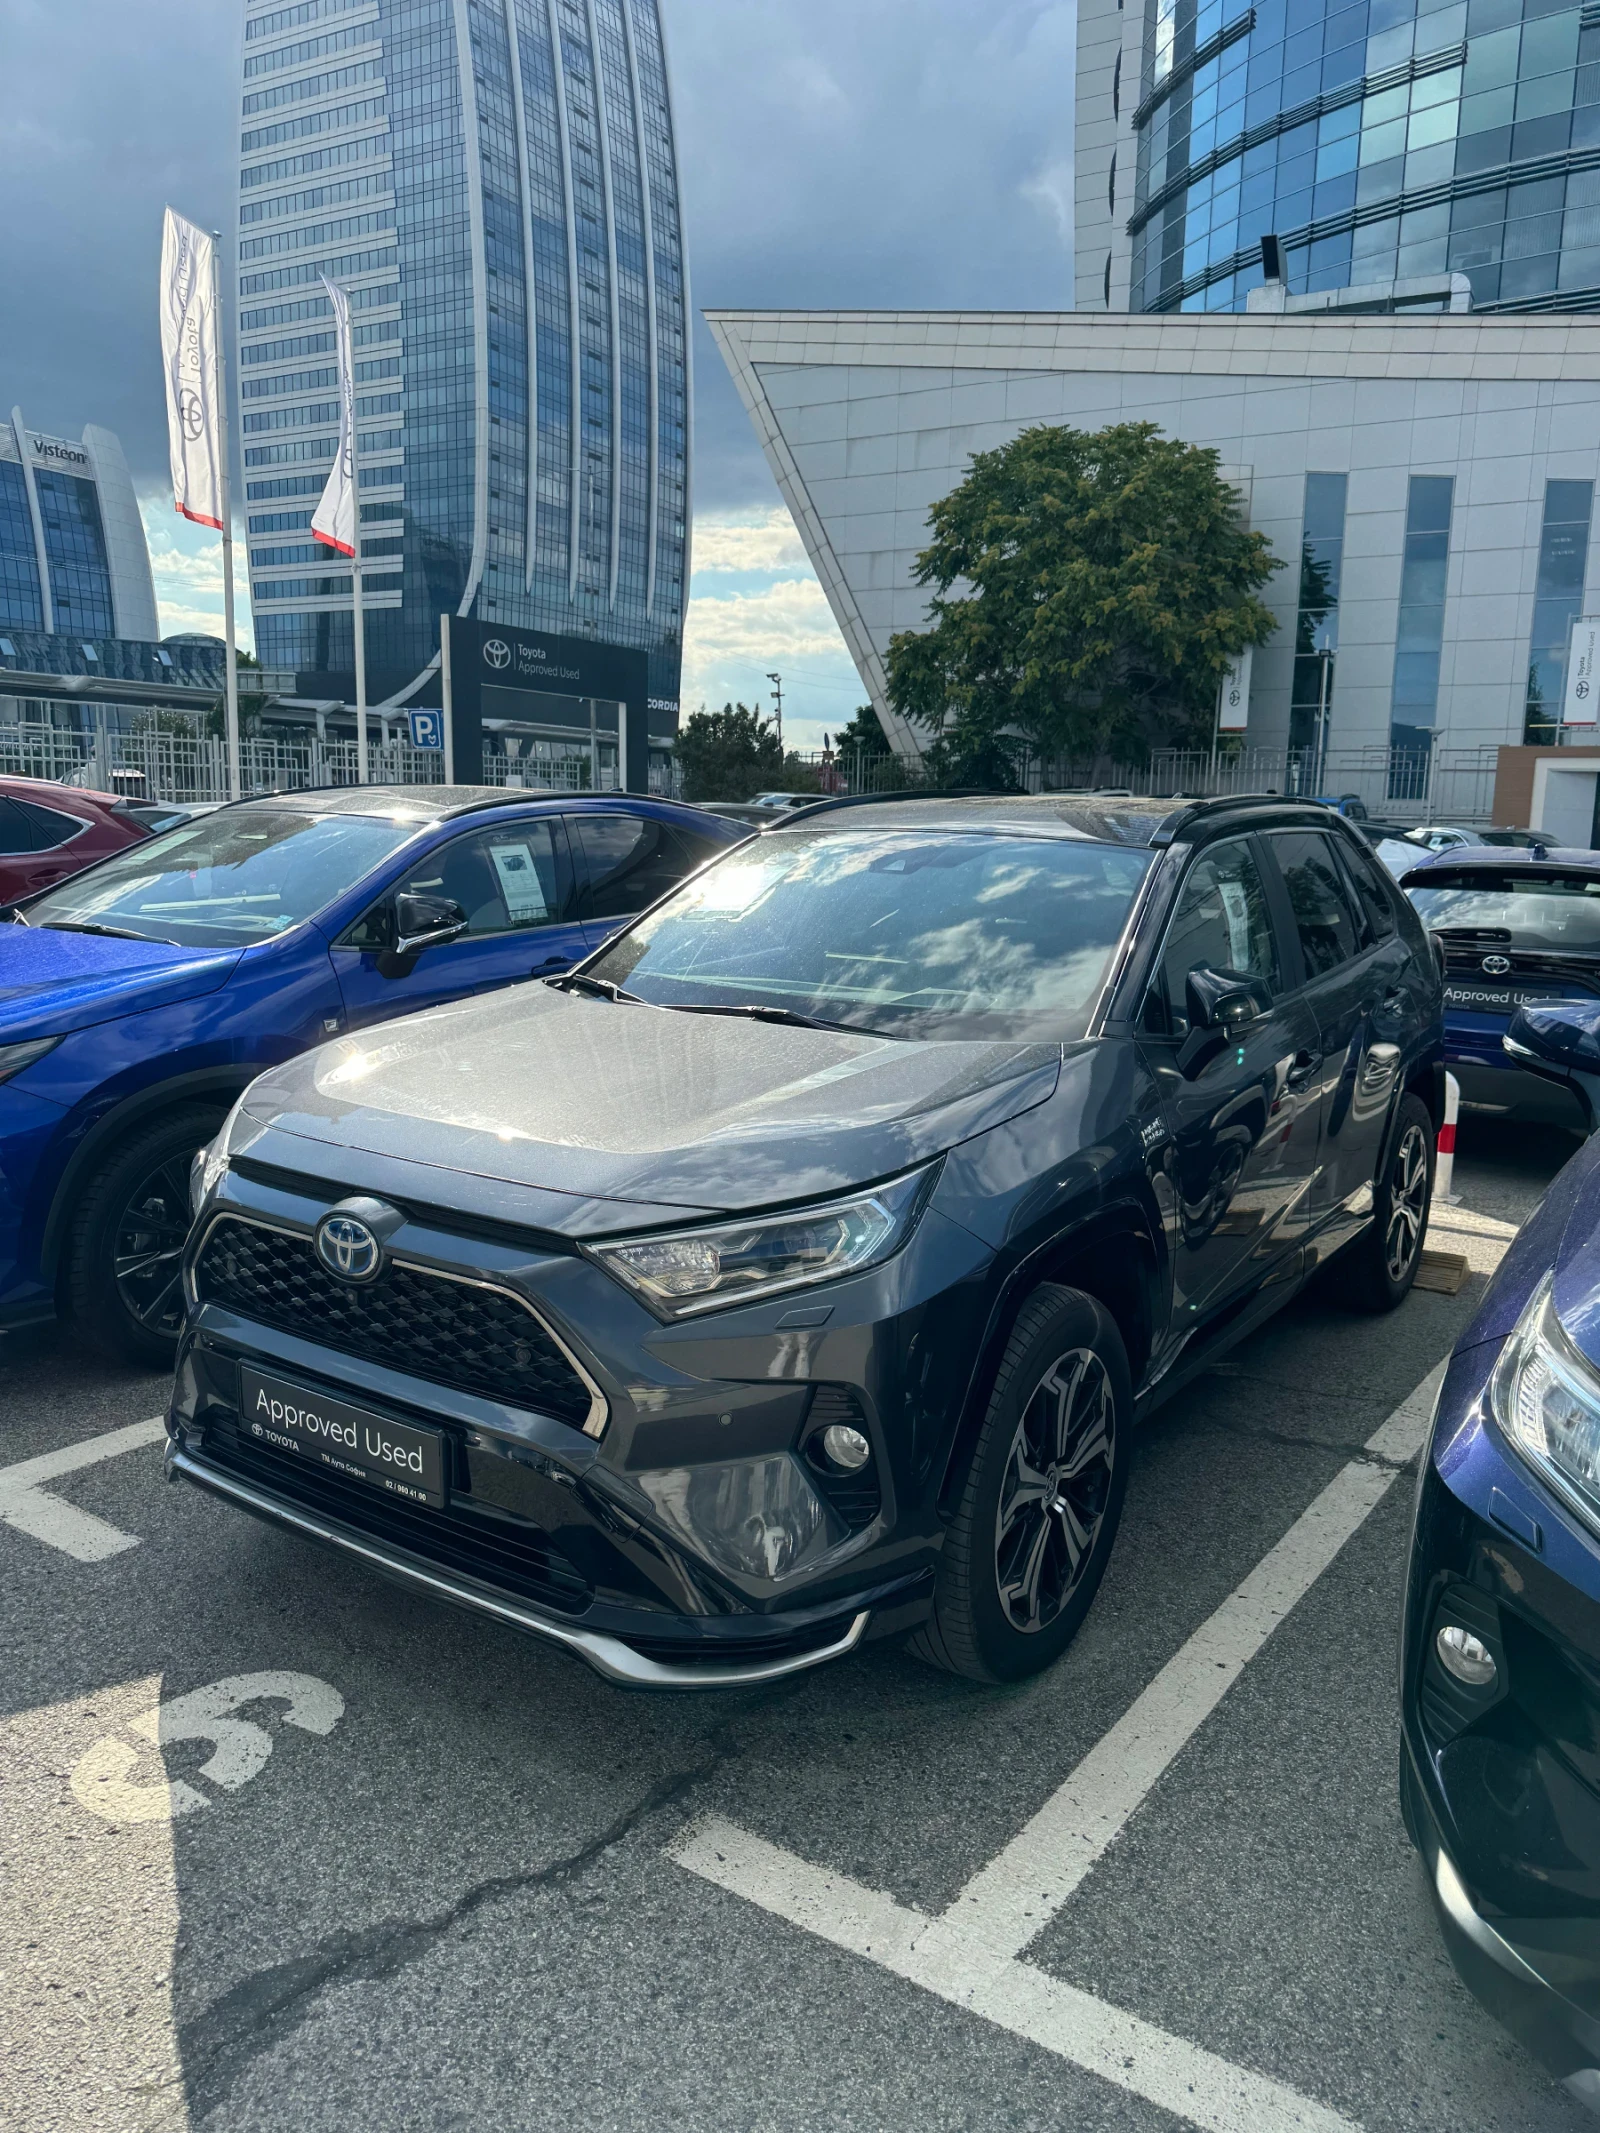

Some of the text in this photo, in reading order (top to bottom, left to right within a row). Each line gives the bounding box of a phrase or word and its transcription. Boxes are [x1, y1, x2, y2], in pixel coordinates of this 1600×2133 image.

[33, 439, 86, 465] Visteon
[518, 643, 547, 660] Toyota
[518, 660, 580, 680] Approved Used
[1577, 656, 1586, 677] Toyota
[415, 715, 433, 744] P
[1443, 987, 1510, 1004] Approved
[256, 1388, 423, 1474] Approved Used
[265, 1429, 300, 1452] TOYOTA
